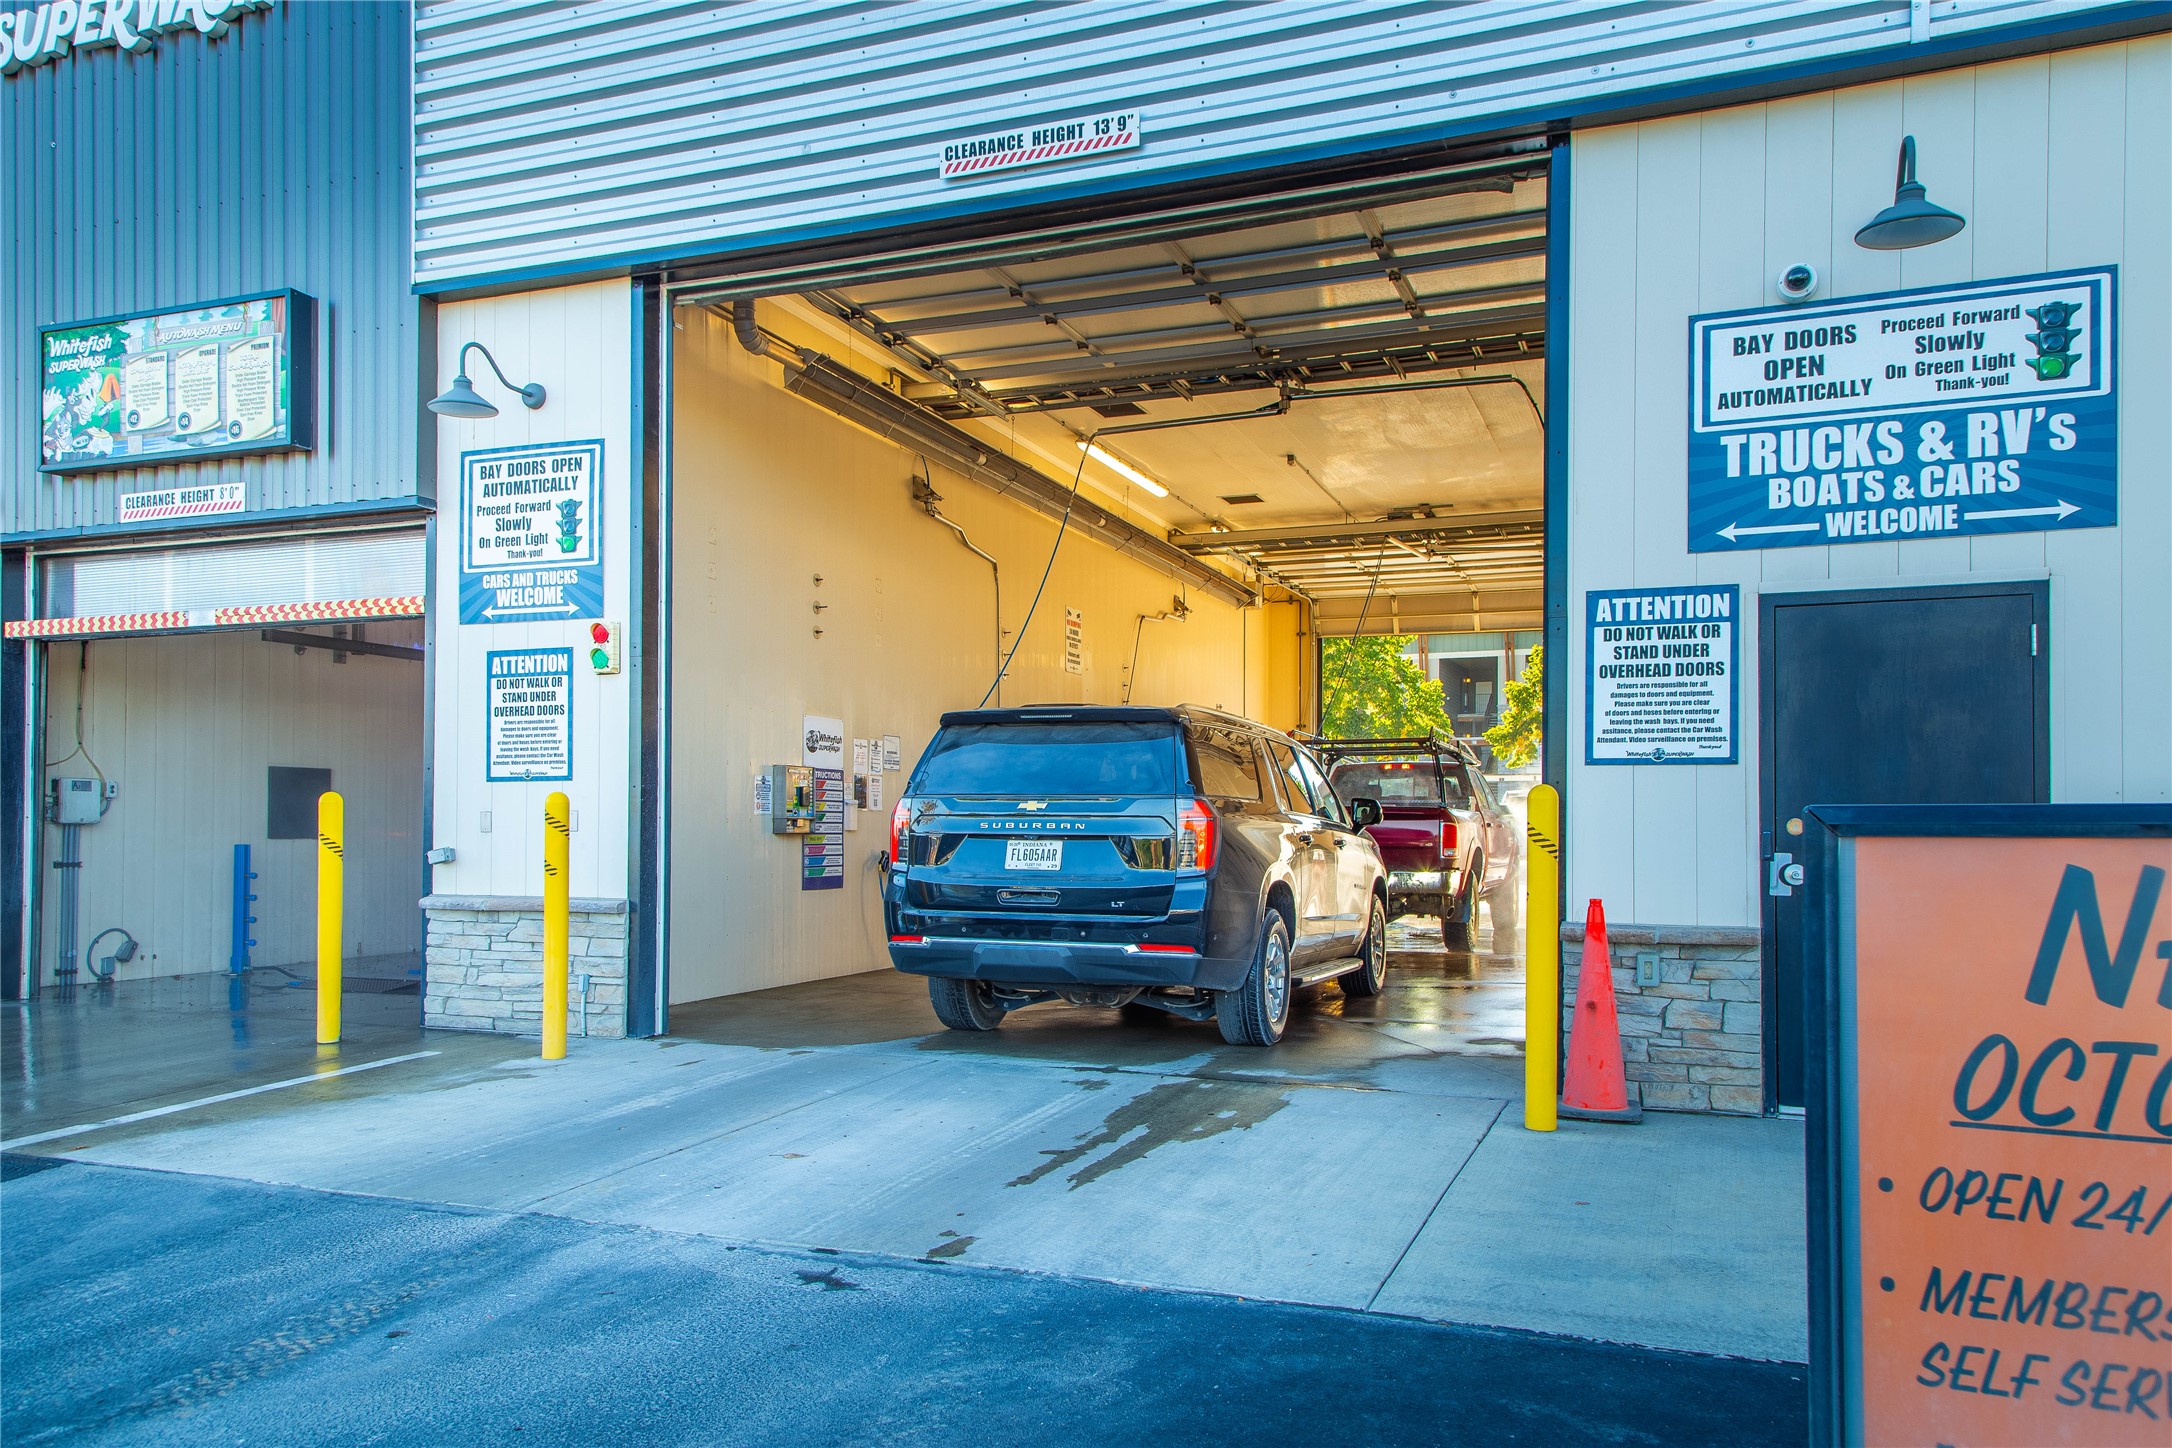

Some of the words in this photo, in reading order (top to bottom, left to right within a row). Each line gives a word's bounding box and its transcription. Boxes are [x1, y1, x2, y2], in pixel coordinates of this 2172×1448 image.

[945, 134, 1024, 161] CLEARANCE
[1032, 123, 1084, 146] HEIGHT
[210, 322, 242, 336] MENU
[1881, 313, 1944, 334] Proceed
[1952, 304, 2021, 327] Forward
[47, 333, 112, 358] Whitefish
[1733, 333, 1774, 356] BAY
[1784, 324, 1856, 349] DOORS
[1914, 330, 1985, 354] Slowly
[48, 354, 106, 374] SUPERWASH
[145, 356, 165, 364] STANDARD
[1764, 355, 1824, 381] OPEN
[1885, 363, 1907, 380] On
[1914, 357, 1964, 378] Green
[1972, 352, 2016, 374] Light
[1936, 372, 2010, 392] Thank-you!
[1718, 378, 1872, 410] AUTOMATICALLY
[1720, 420, 1904, 478] TRUCKS
[1917, 420, 1954, 462] &
[480, 464, 502, 480] BAY
[508, 460, 546, 477] DOORS
[552, 457, 582, 473] OPEN
[483, 476, 579, 498] AUTOMATICALLY
[1769, 470, 1885, 510] BOATS
[1893, 474, 1915, 499] &
[1920, 459, 2020, 498] CARS
[126, 493, 175, 509] CLEARANCE
[181, 489, 214, 504] HEIGHT
[477, 503, 511, 516] Proceed
[515, 500, 551, 513] Forward
[495, 516, 532, 531] Slowly
[1825, 504, 1958, 538] WELCOME
[479, 538, 490, 548] On
[495, 536, 521, 547] Green
[526, 533, 548, 546] Light
[507, 548, 543, 559] Thank-you!
[483, 574, 510, 589] CARS
[512, 572, 533, 587] AND
[536, 570, 578, 585] TRUCKS
[496, 587, 564, 607] WELCOME
[1596, 593, 1729, 622] ATTENTION
[1604, 628, 1622, 642] DO
[1626, 626, 1653, 641] NOT
[1657, 625, 1698, 640] WALK
[1702, 624, 1720, 638] OR
[1614, 645, 1658, 660] STAND
[1663, 643, 1709, 658] UNDER
[492, 654, 568, 675] ATTENTION
[1599, 663, 1671, 678] OVERHEAD
[1675, 661, 1724, 676] DOORS
[497, 679, 507, 689] DO
[509, 678, 525, 689] NOT
[527, 678, 549, 688] WALK
[552, 677, 562, 687] OR
[502, 692, 528, 703] STAND
[530, 691, 556, 702] UNDER
[494, 706, 534, 717] OVERHEAD
[537, 705, 565, 716] DOORS
[1011, 848, 1057, 861] FL605AAR
[1919, 1166, 2064, 1225] OPEN
[1916, 1342, 2051, 1400] SELF
[2055, 1360, 2172, 1420] SER
